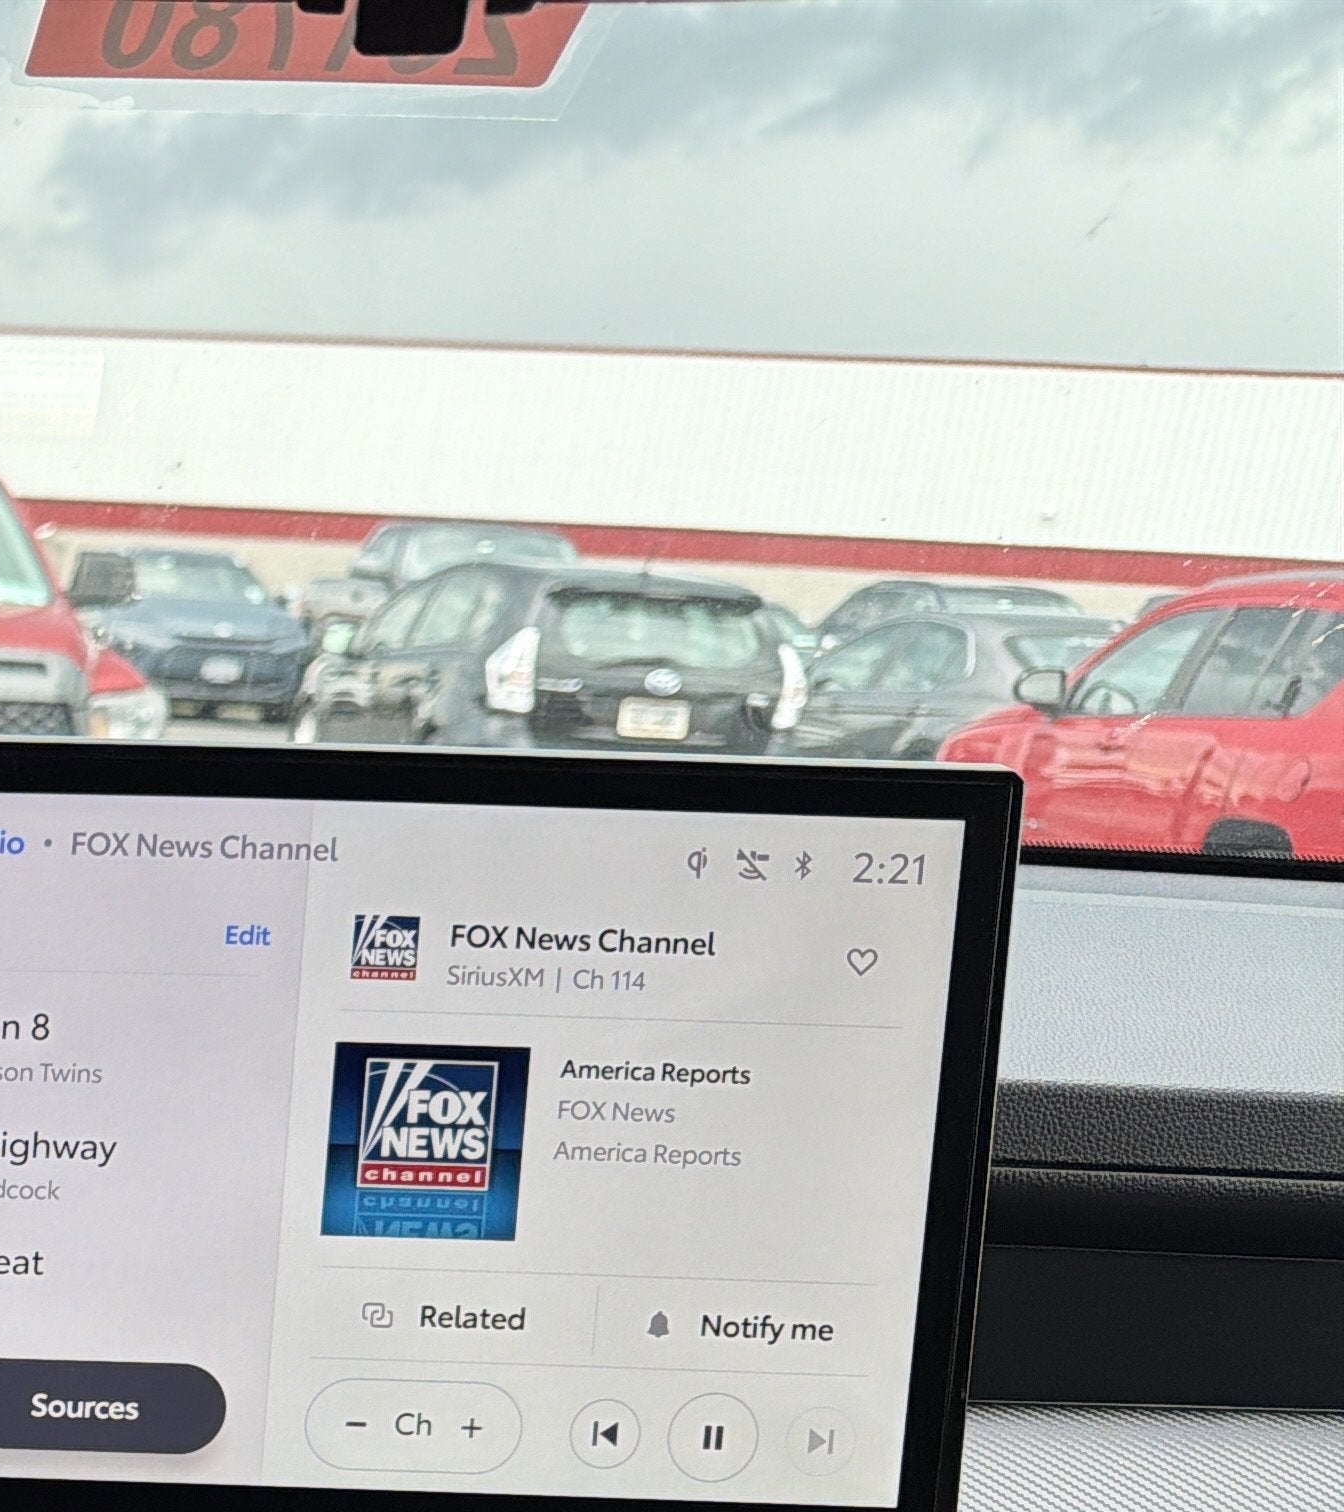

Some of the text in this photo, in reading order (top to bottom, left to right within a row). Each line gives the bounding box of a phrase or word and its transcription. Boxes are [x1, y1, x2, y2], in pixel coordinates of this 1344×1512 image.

[70, 831, 130, 859] FOX
[136, 832, 213, 861] News
[219, 834, 340, 864] Channel
[852, 852, 927, 885] 2:21
[224, 923, 271, 947] Edit
[374, 929, 417, 949] FOX
[450, 924, 717, 958] FOX News Channel
[361, 949, 416, 967] NEWS
[446, 964, 647, 992] SiriusXM Ch 114
[31, 1012, 51, 1041] 8
[39, 1062, 103, 1085] Twins
[559, 1060, 751, 1087] America Reports
[406, 1089, 488, 1126] FOX
[557, 1100, 676, 1124] FOX News
[379, 1126, 487, 1160] NEWS
[552, 1142, 742, 1169] America Reports
[364, 1167, 482, 1185] channel
[419, 1305, 527, 1331] Related
[700, 1315, 835, 1345] Notify me
[30, 1393, 140, 1421] Sources
[394, 1412, 433, 1438] Ch
